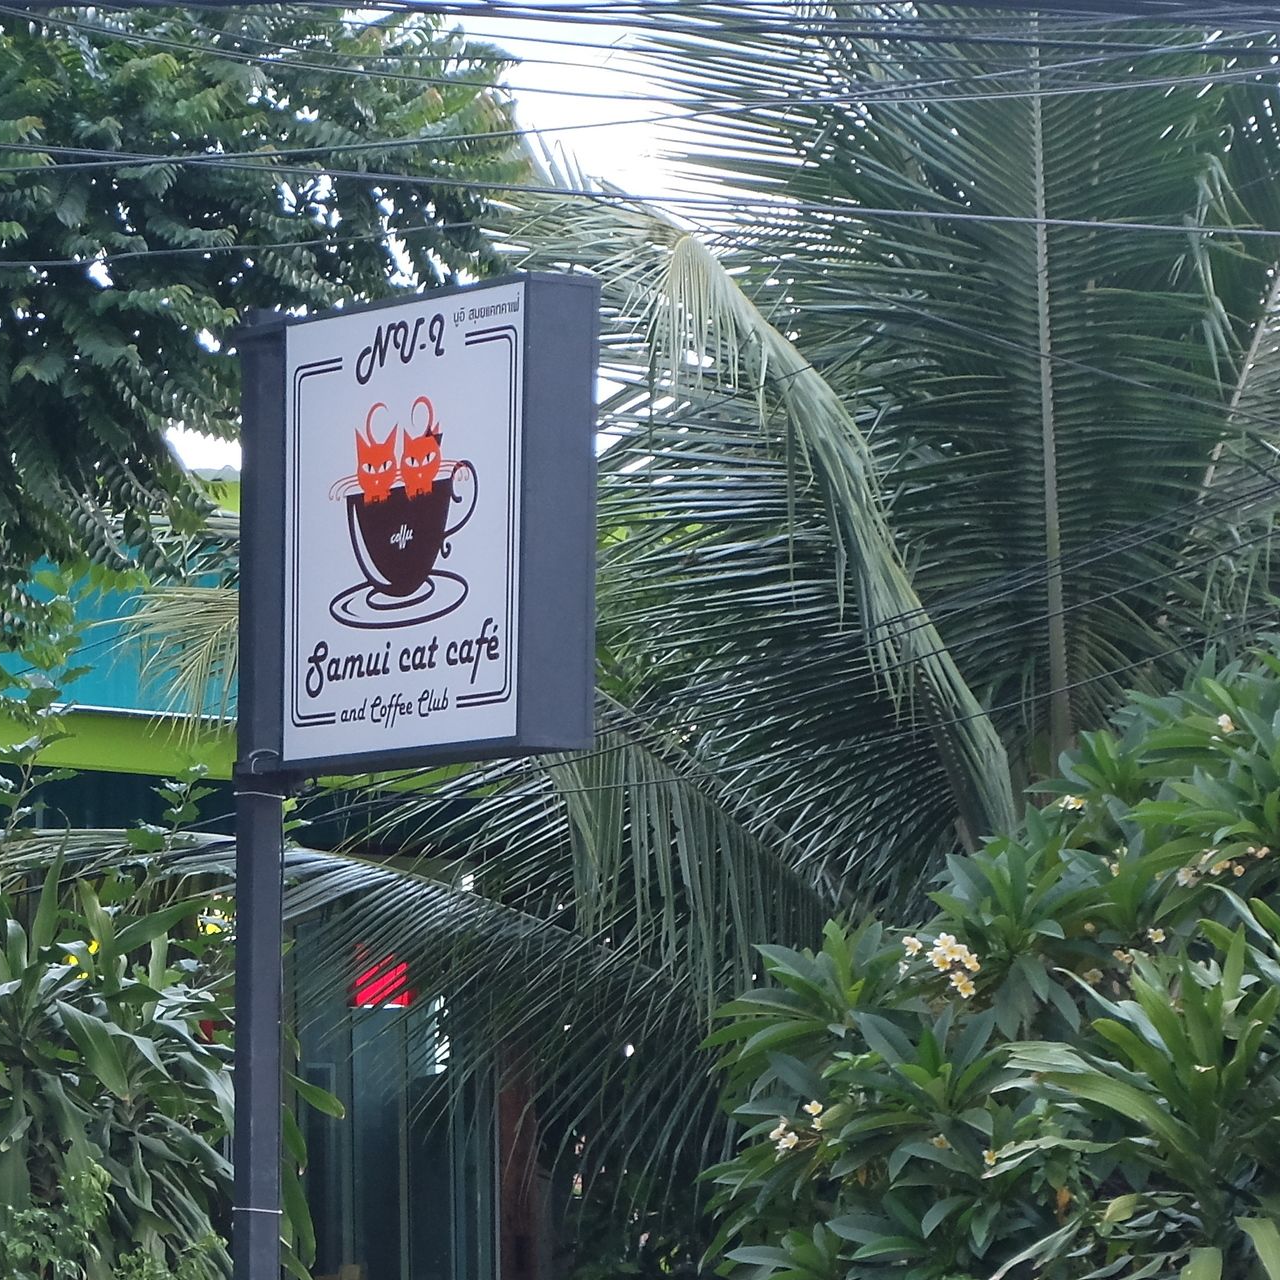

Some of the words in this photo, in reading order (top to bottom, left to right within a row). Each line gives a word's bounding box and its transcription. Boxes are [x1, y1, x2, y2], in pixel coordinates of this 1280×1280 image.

[305, 640, 391, 699] Samui
[399, 636, 439, 672] cat
[446, 617, 500, 684] café
[340, 698, 366, 723] and
[370, 692, 413, 729] Coffee
[418, 687, 449, 717] Club
